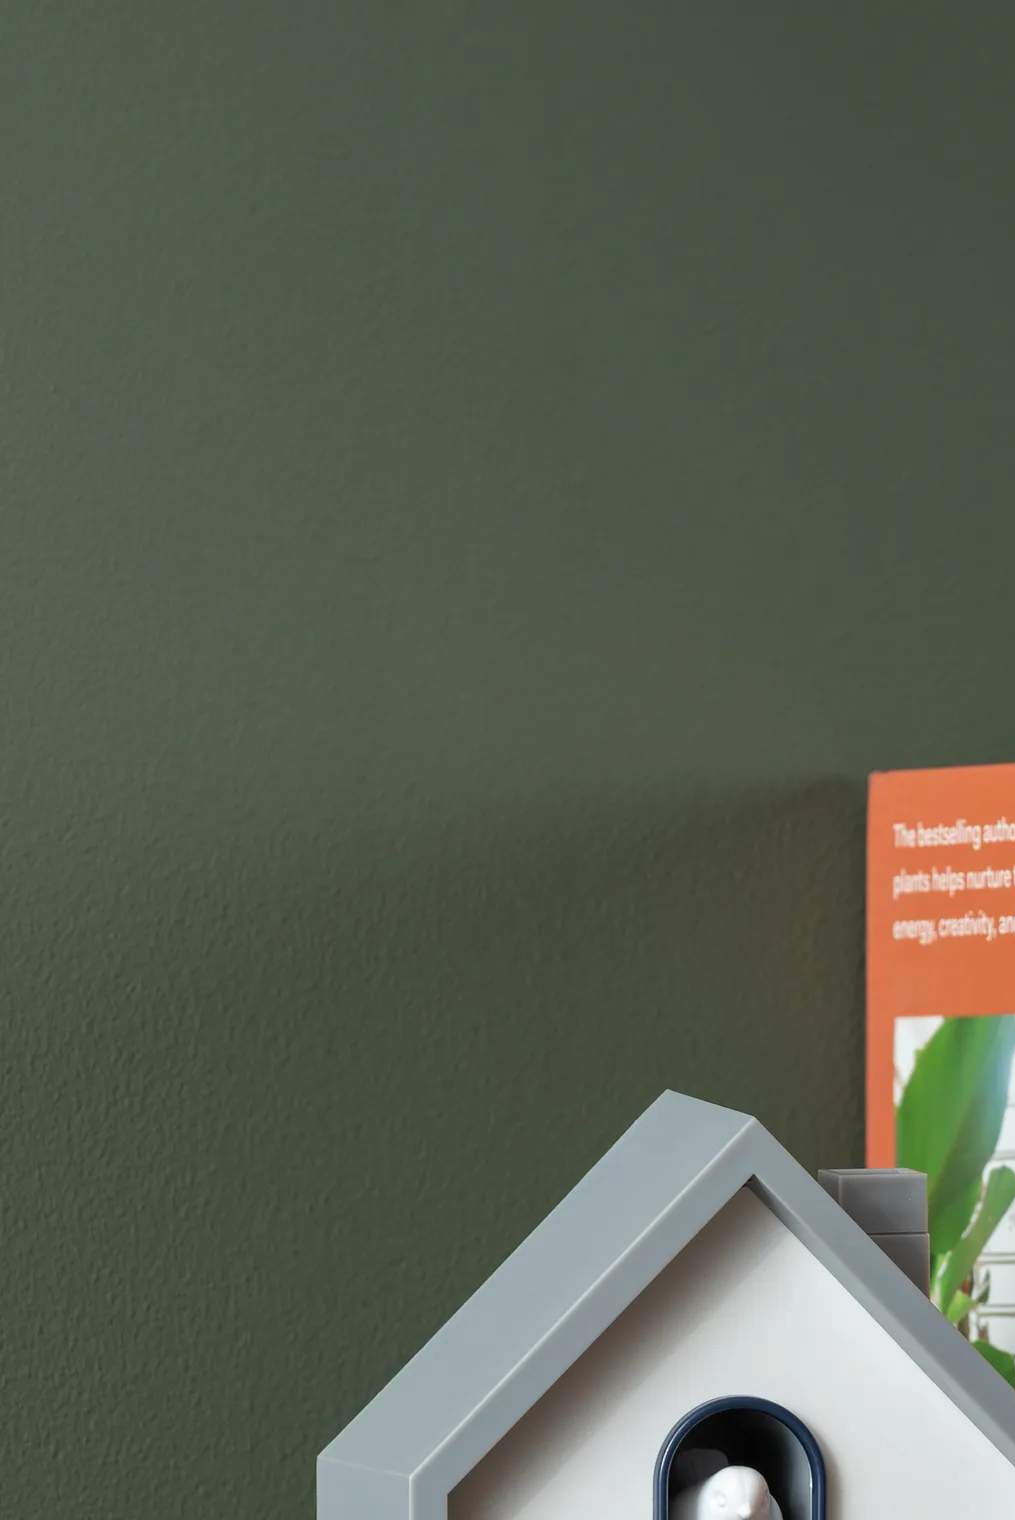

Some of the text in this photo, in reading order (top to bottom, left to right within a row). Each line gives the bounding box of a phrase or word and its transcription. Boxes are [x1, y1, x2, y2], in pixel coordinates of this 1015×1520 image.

[894, 824, 915, 848] The
[917, 819, 981, 850] bestselling
[893, 870, 931, 898] plants
[932, 867, 965, 896] helps
[966, 867, 1012, 889] nurture
